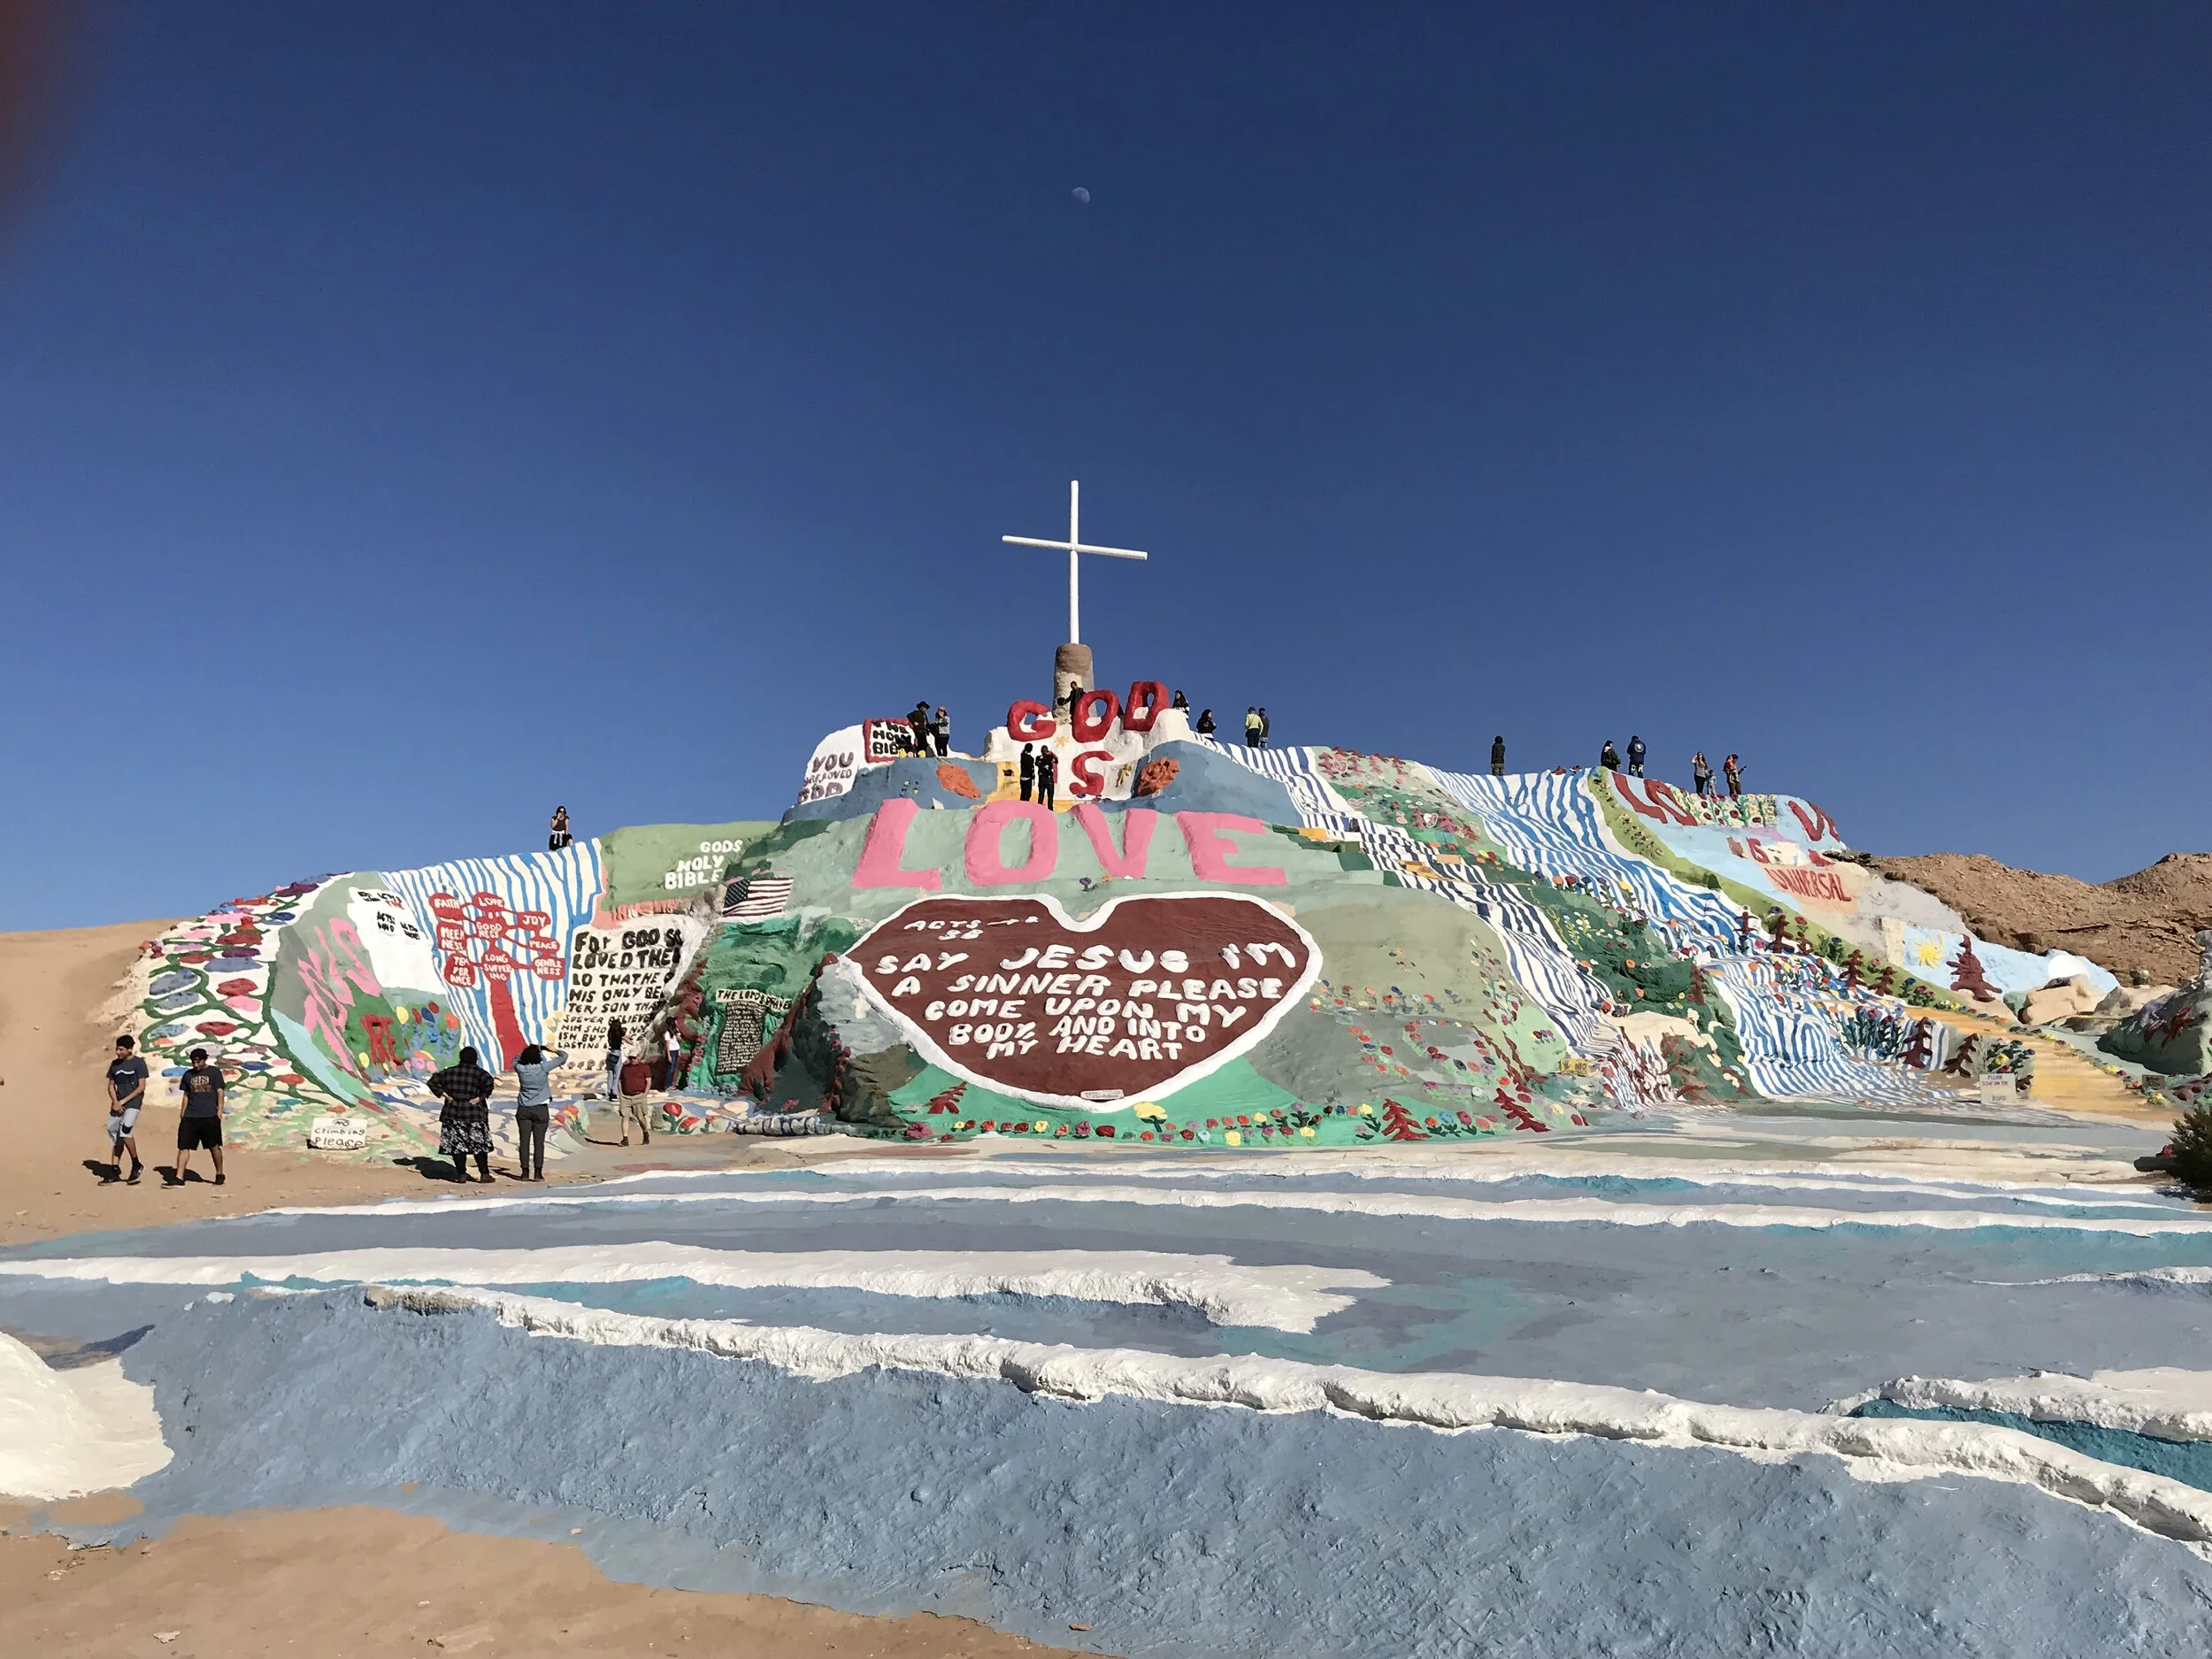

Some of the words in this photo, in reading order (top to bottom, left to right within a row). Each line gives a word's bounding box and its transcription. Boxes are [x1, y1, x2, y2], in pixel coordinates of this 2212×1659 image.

[1007, 680, 1170, 743] GOD
[872, 741, 901, 755] BIB
[812, 752, 854, 773] YOU
[798, 782, 843, 804] GOD
[700, 840, 743, 853] GODS
[852, 798, 1288, 891] LOVE
[664, 869, 723, 890] BIBLE
[1764, 868, 1852, 902] UNIVERSAL
[434, 898, 460, 910] FAITH
[478, 896, 503, 908] LOVE
[476, 922, 503, 932] GOOD
[522, 915, 547, 927] JOY
[903, 919, 981, 931] ACTS
[442, 940, 464, 950] NESS
[529, 941, 558, 949] PEACE
[485, 954, 509, 964] LONG
[572, 952, 634, 970] LOVED
[874, 952, 970, 974] SAY
[1000, 944, 1189, 973] JESUS
[452, 966, 469, 977] PER
[536, 966, 562, 976] NESS
[449, 975, 472, 986] ANCE
[599, 973, 641, 987] THAT
[891, 976, 921, 997] A
[947, 972, 1111, 996] SINNER
[1128, 978, 1283, 1001] PLEASE
[603, 987, 642, 1001] ONLY
[718, 990, 737, 1000] THE
[602, 1002, 631, 1013] SON
[925, 998, 1026, 1021] COME
[1044, 997, 1154, 1018] UPON
[1176, 1002, 1248, 1028] MY
[582, 1033, 606, 1042] BUT
[949, 1022, 1036, 1046] BODY
[1048, 1016, 1116, 1038] AND
[1127, 1018, 1207, 1043] INTO
[986, 1039, 1039, 1060] MY
[1056, 1035, 1183, 1061] HEART
